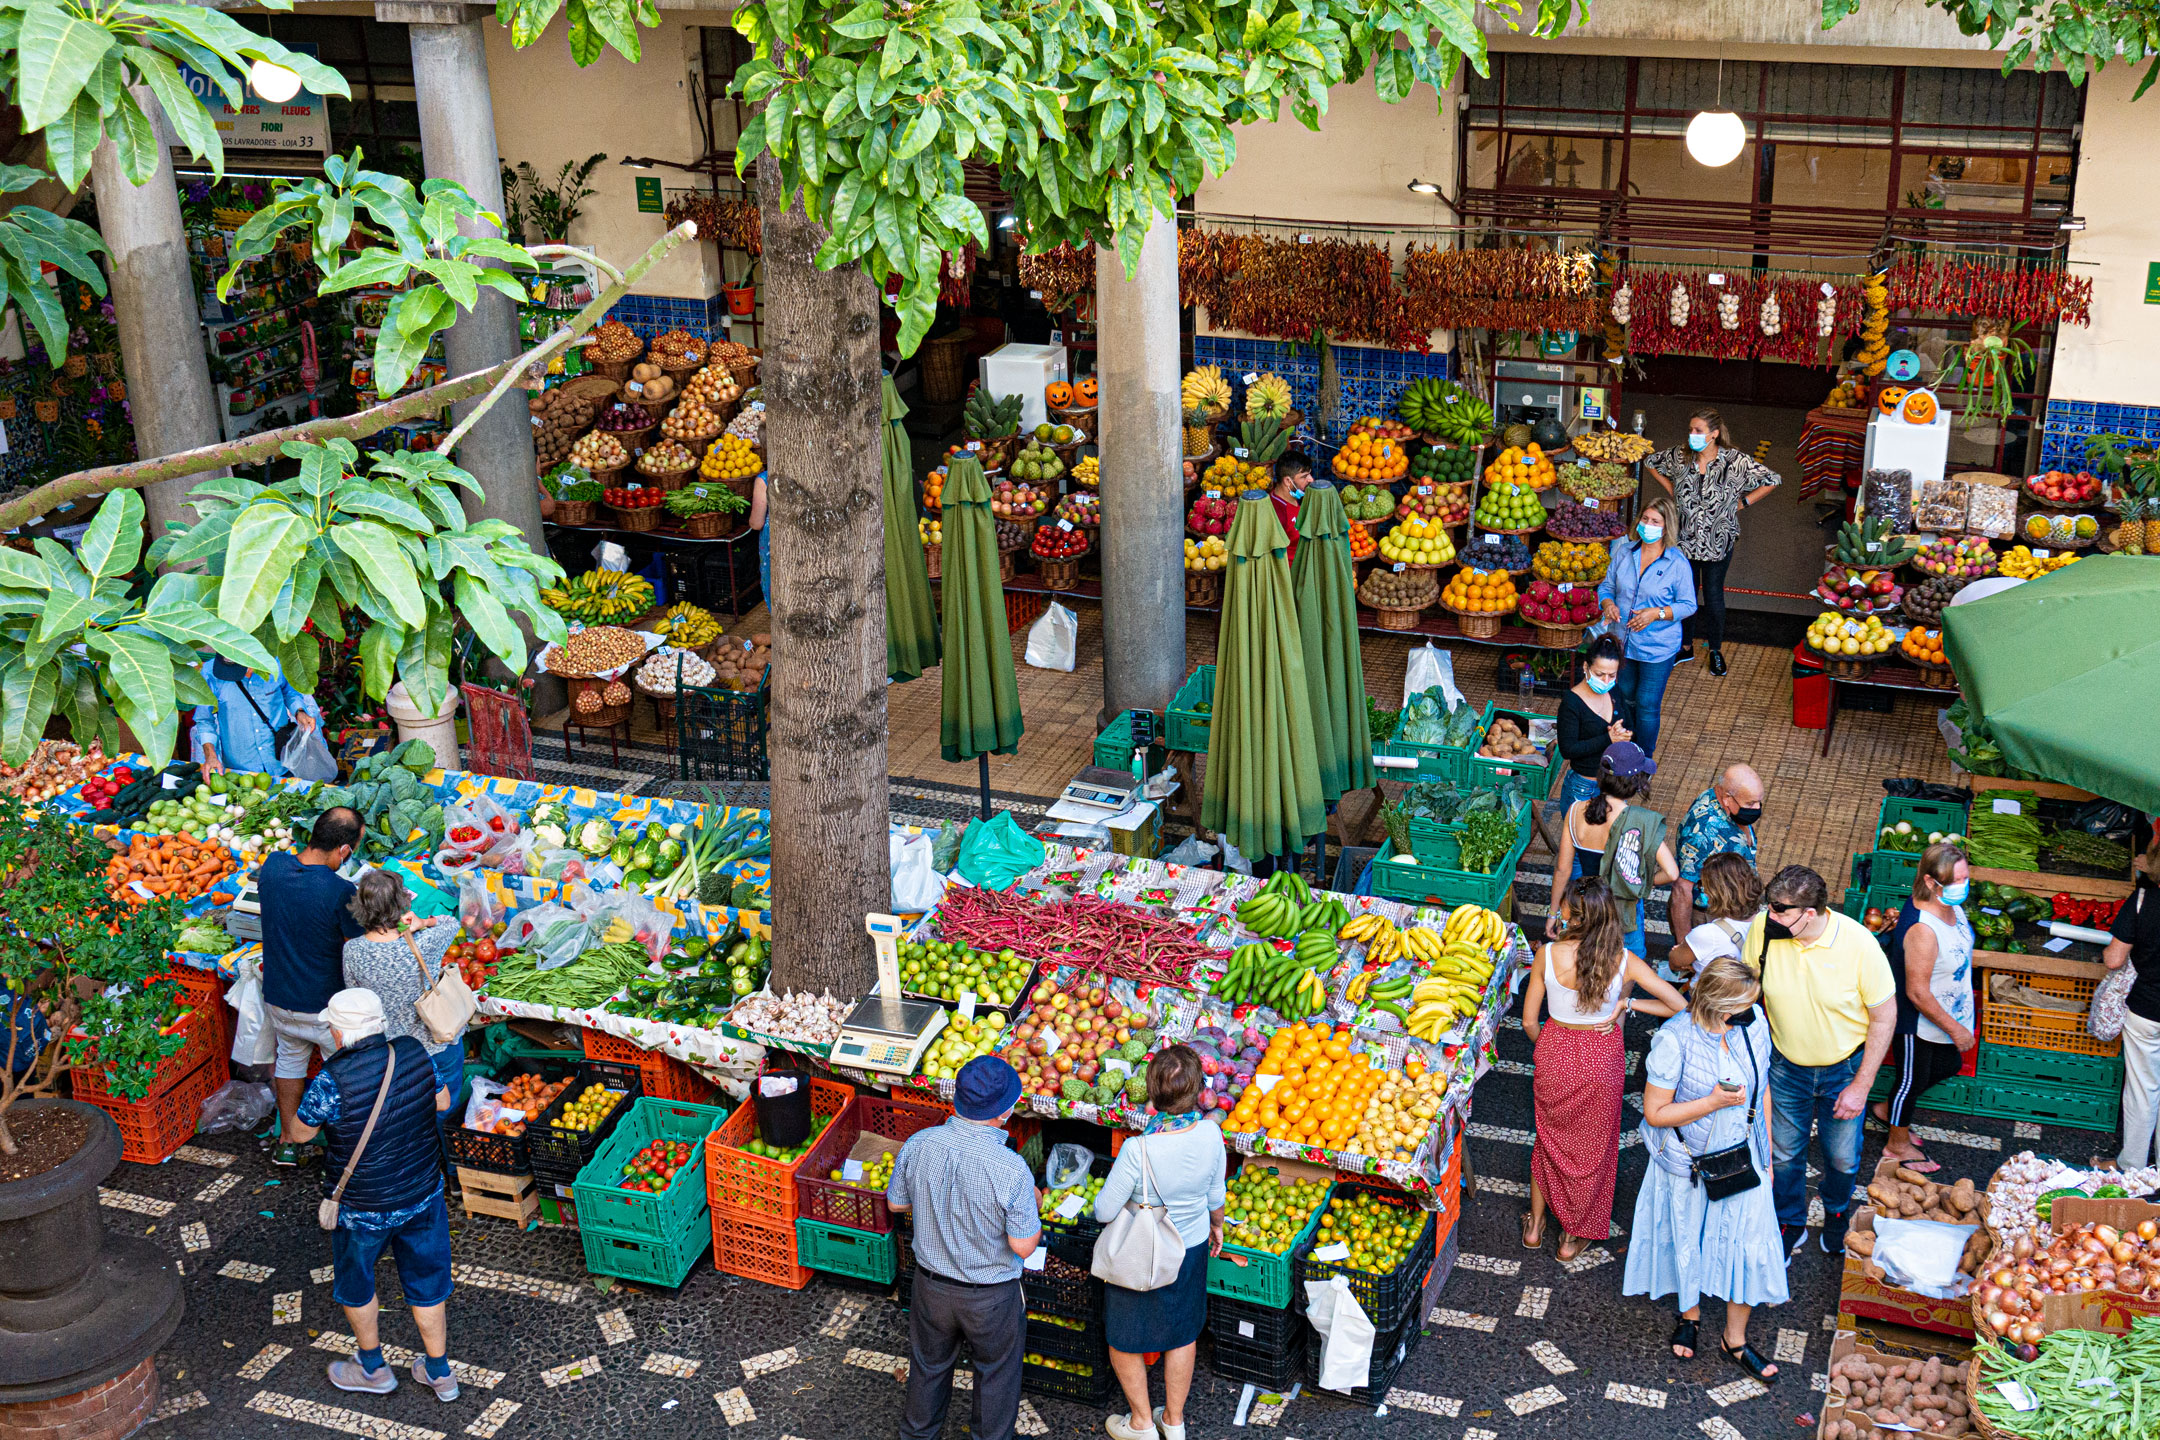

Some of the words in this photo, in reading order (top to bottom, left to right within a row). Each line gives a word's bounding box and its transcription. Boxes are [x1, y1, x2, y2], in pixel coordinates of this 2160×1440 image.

[281, 106, 311, 116] FLEURS
[261, 122, 283, 132] FIORI
[234, 138, 277, 147] LAVRADORES
[282, 139, 297, 147] LOJA
[299, 136, 314, 148] 33
[1879, 1288, 1920, 1303] Banana
[1927, 1299, 1971, 1314] Madeira
[1875, 1341, 1914, 1357] Banana
